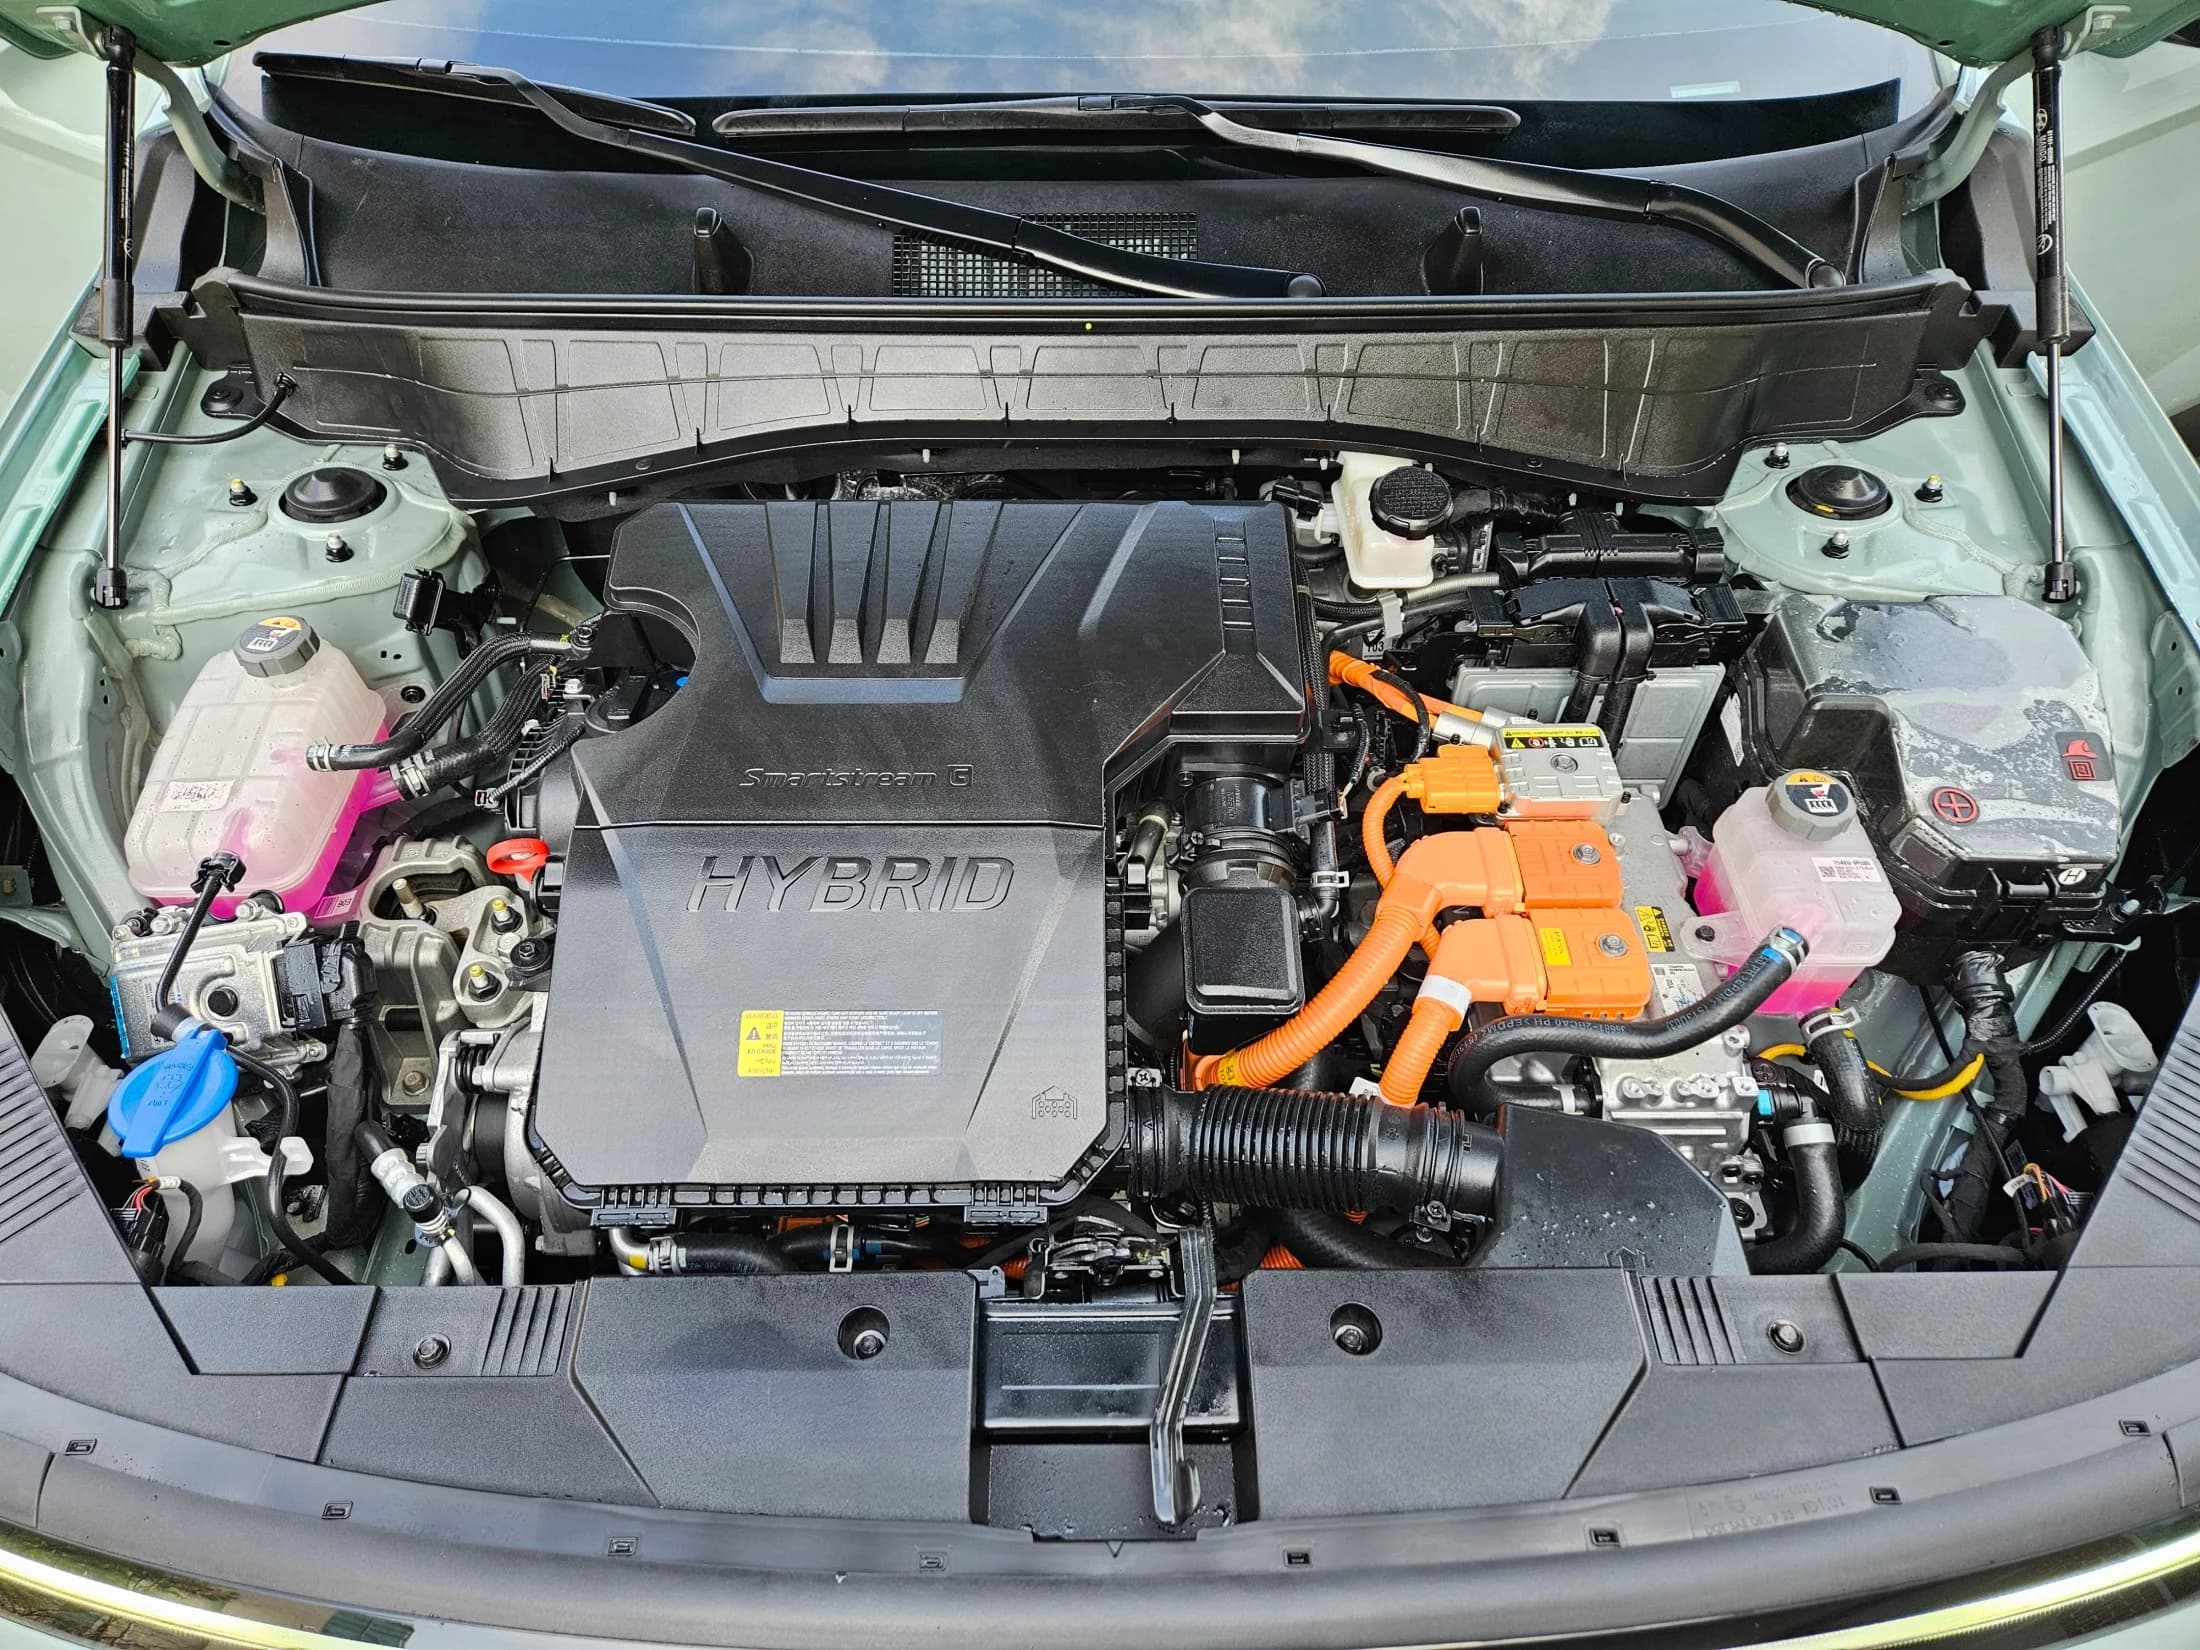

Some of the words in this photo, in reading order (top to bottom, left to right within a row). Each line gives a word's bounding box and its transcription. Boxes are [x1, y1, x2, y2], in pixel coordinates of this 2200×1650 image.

[739, 767, 937, 787] Smartstream
[948, 765, 973, 787] G
[686, 855, 1015, 912] HYBRID
